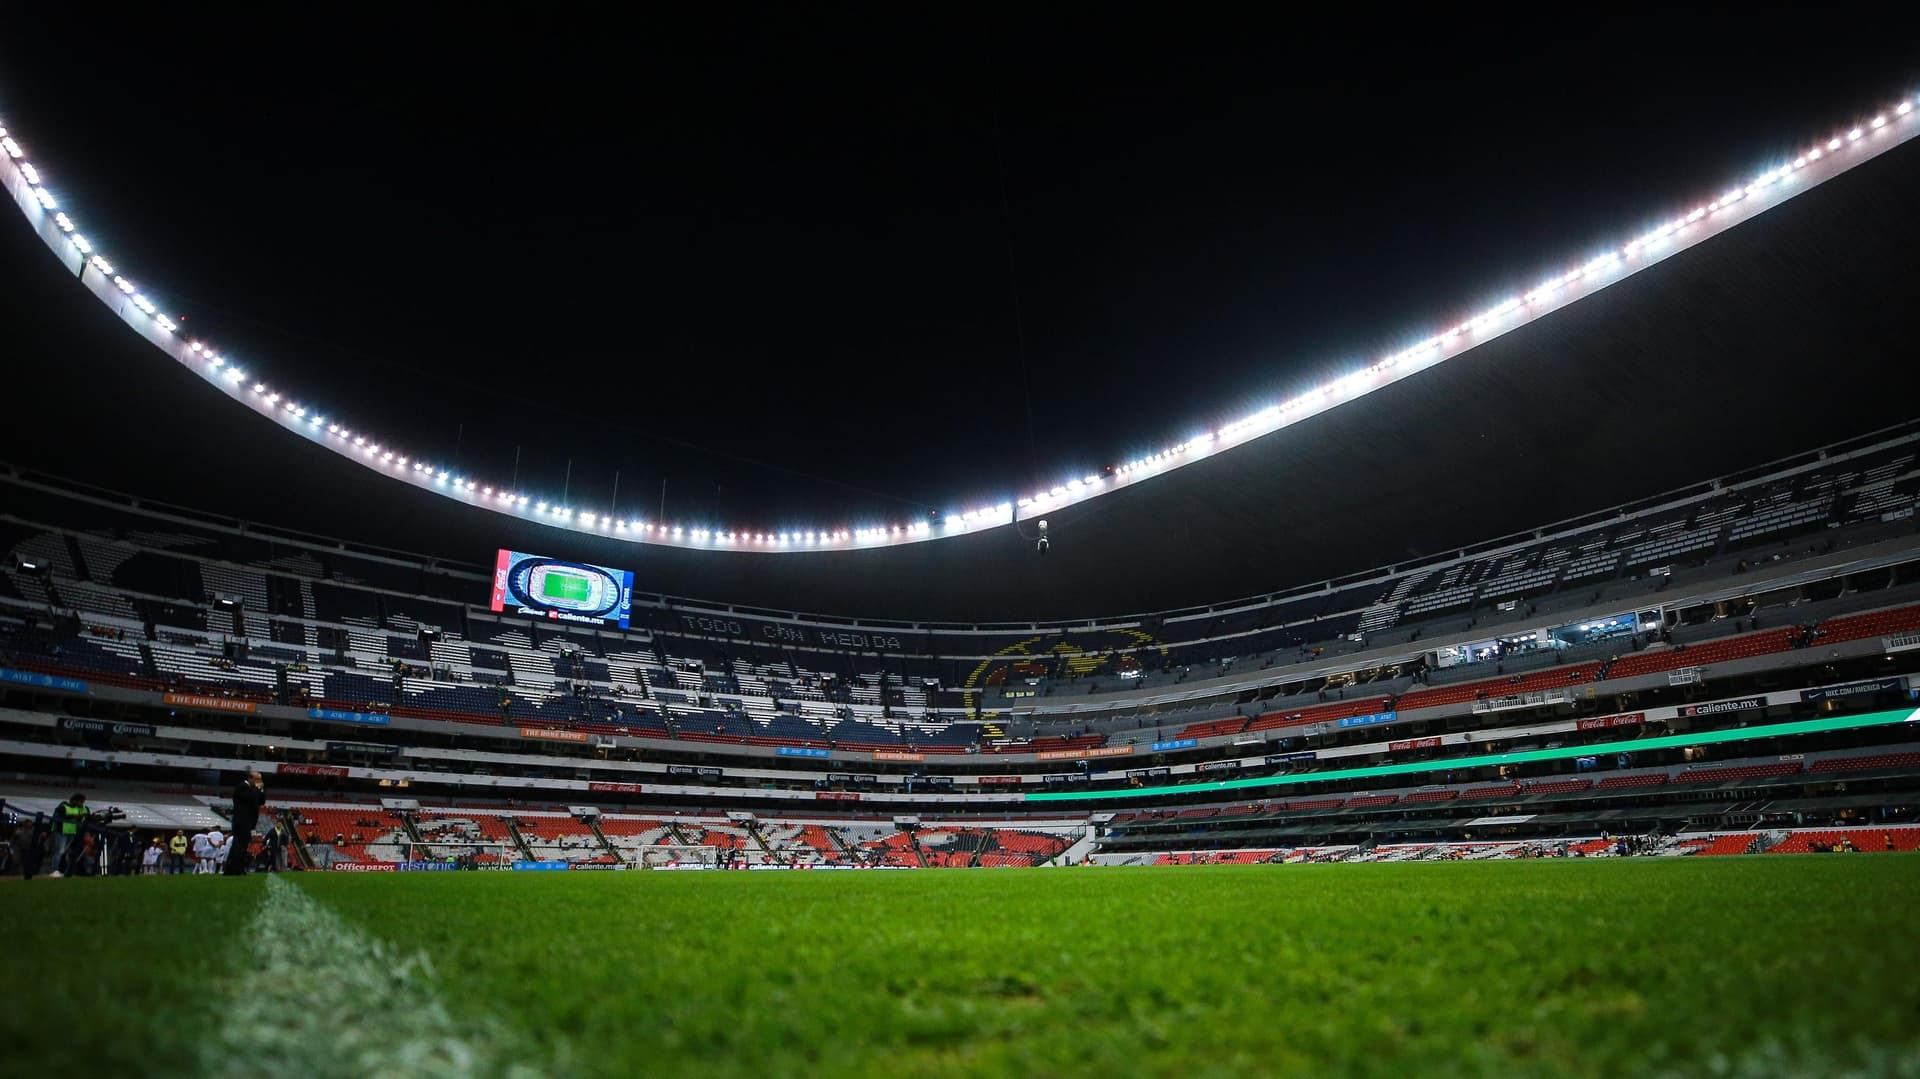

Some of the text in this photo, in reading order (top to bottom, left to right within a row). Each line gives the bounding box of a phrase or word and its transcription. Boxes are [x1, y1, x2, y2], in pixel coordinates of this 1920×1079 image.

[681, 616, 742, 634] TODO
[819, 631, 901, 649] MEDIDA
[170, 695, 251, 711] THE HOME DEPOT
[1696, 698, 1759, 715] caliente.mx
[63, 719, 151, 735] Corona Corona
[1204, 761, 1237, 771] caliente.mx
[335, 863, 365, 871] Office
